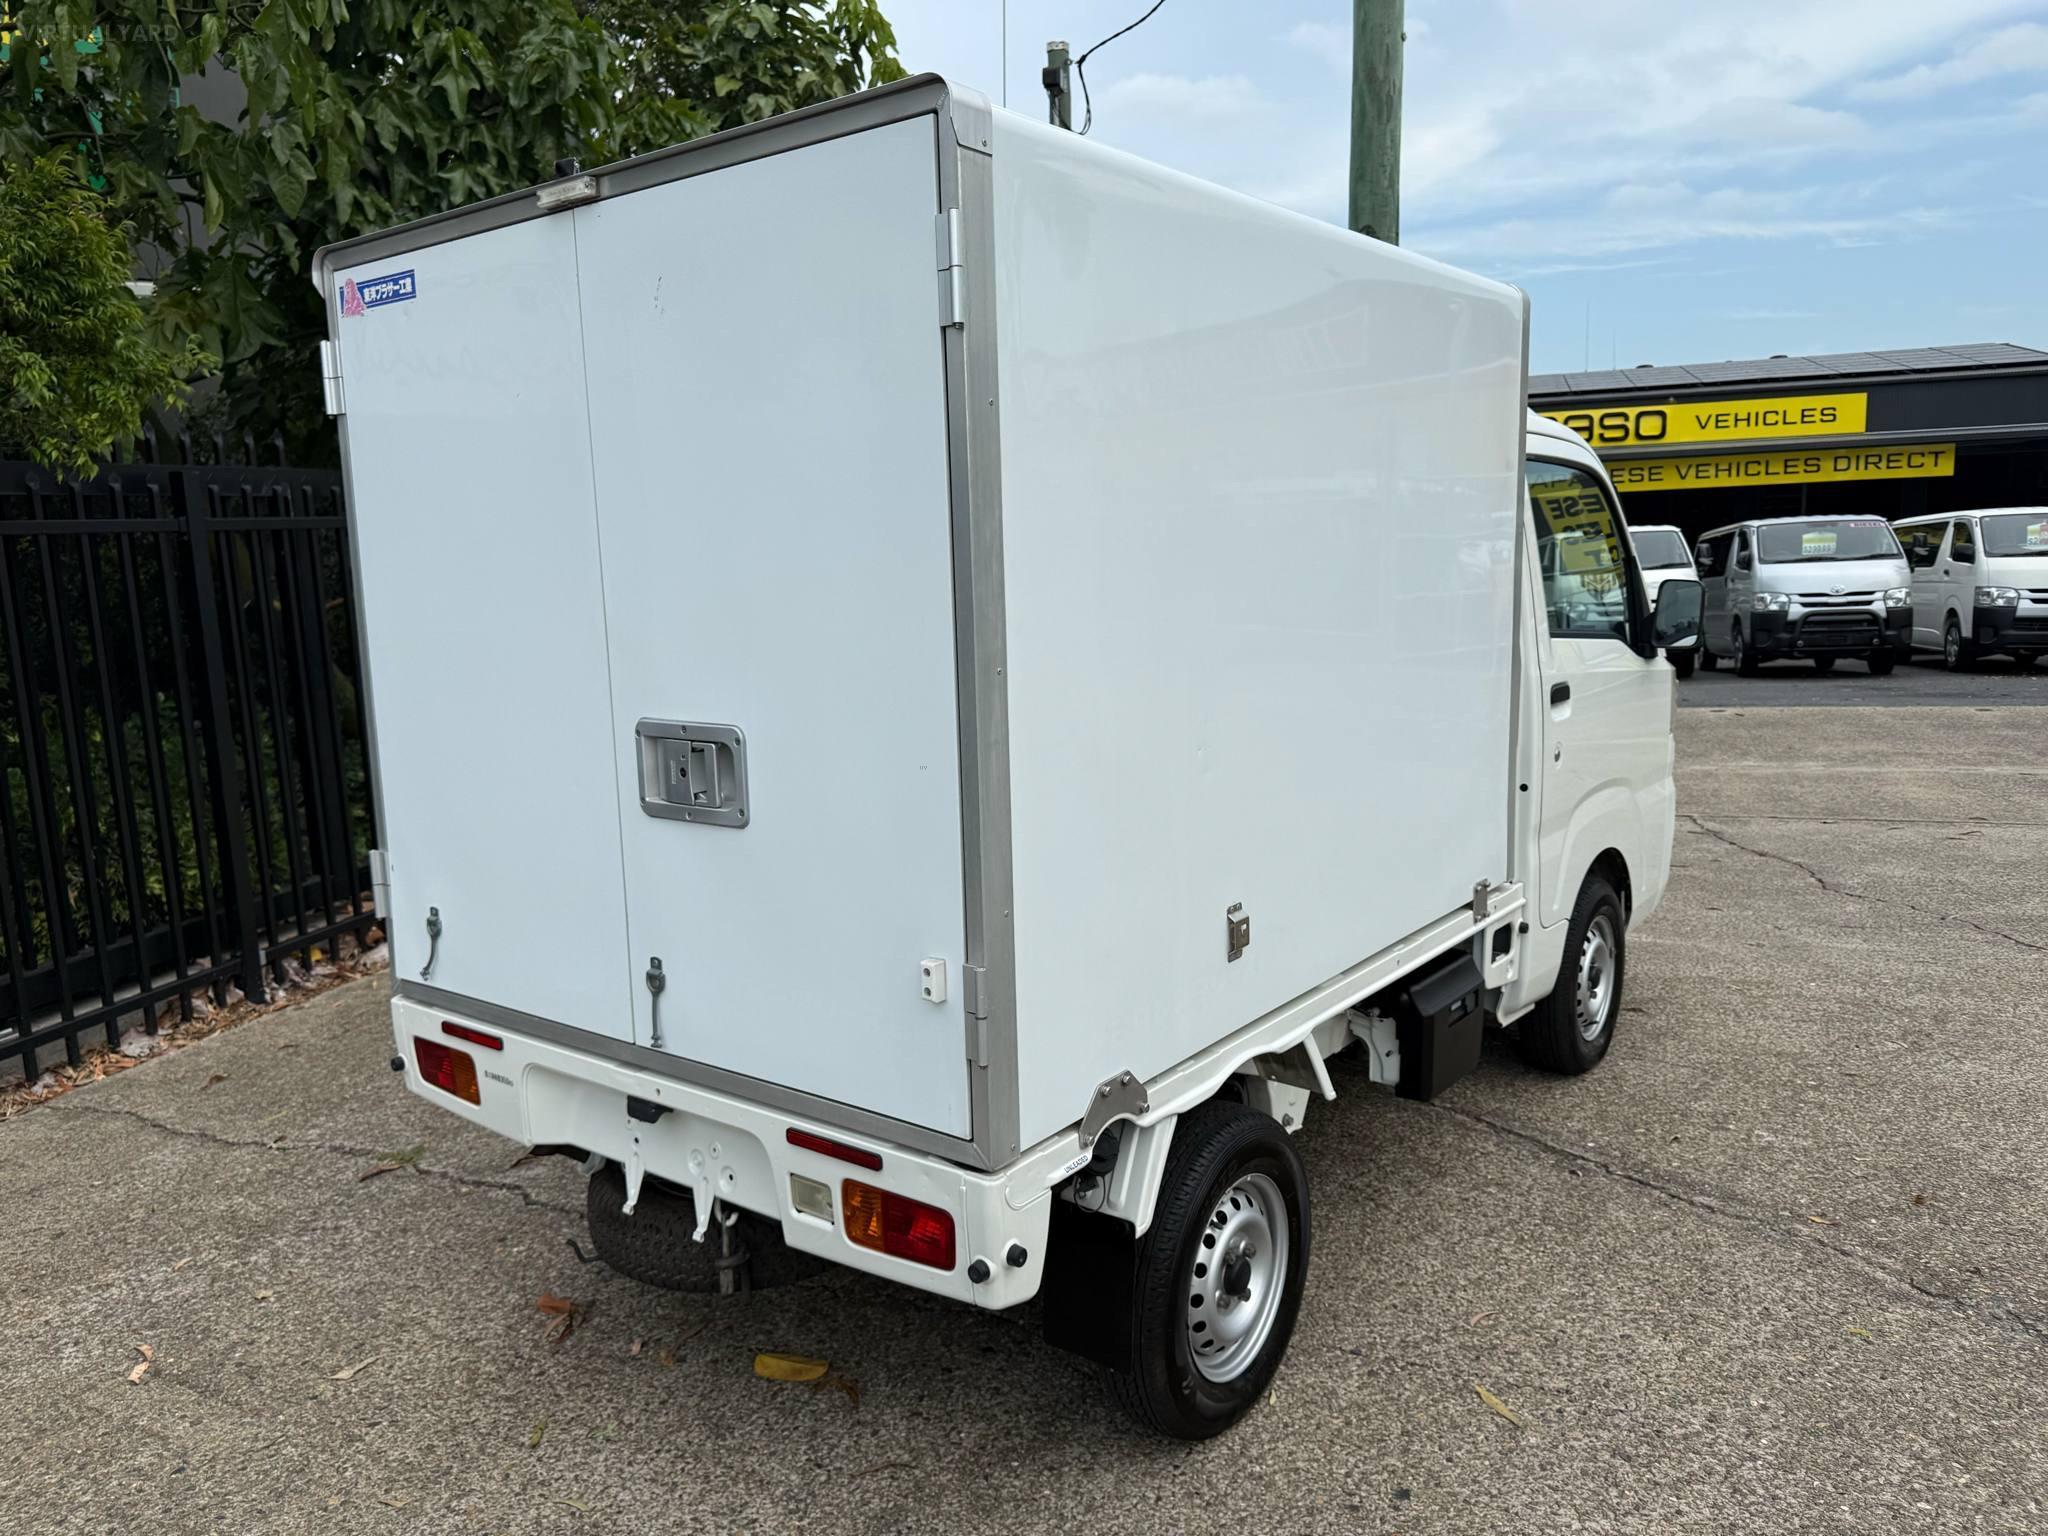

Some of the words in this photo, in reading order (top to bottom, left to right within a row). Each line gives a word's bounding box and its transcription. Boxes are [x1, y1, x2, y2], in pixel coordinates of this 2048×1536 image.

[1695, 406, 1838, 431] VEHICLES
[1675, 456, 1822, 481] VEHICLES
[1833, 450, 1947, 474] DIRECT
[1064, 1155, 1088, 1174] UNLEADED
